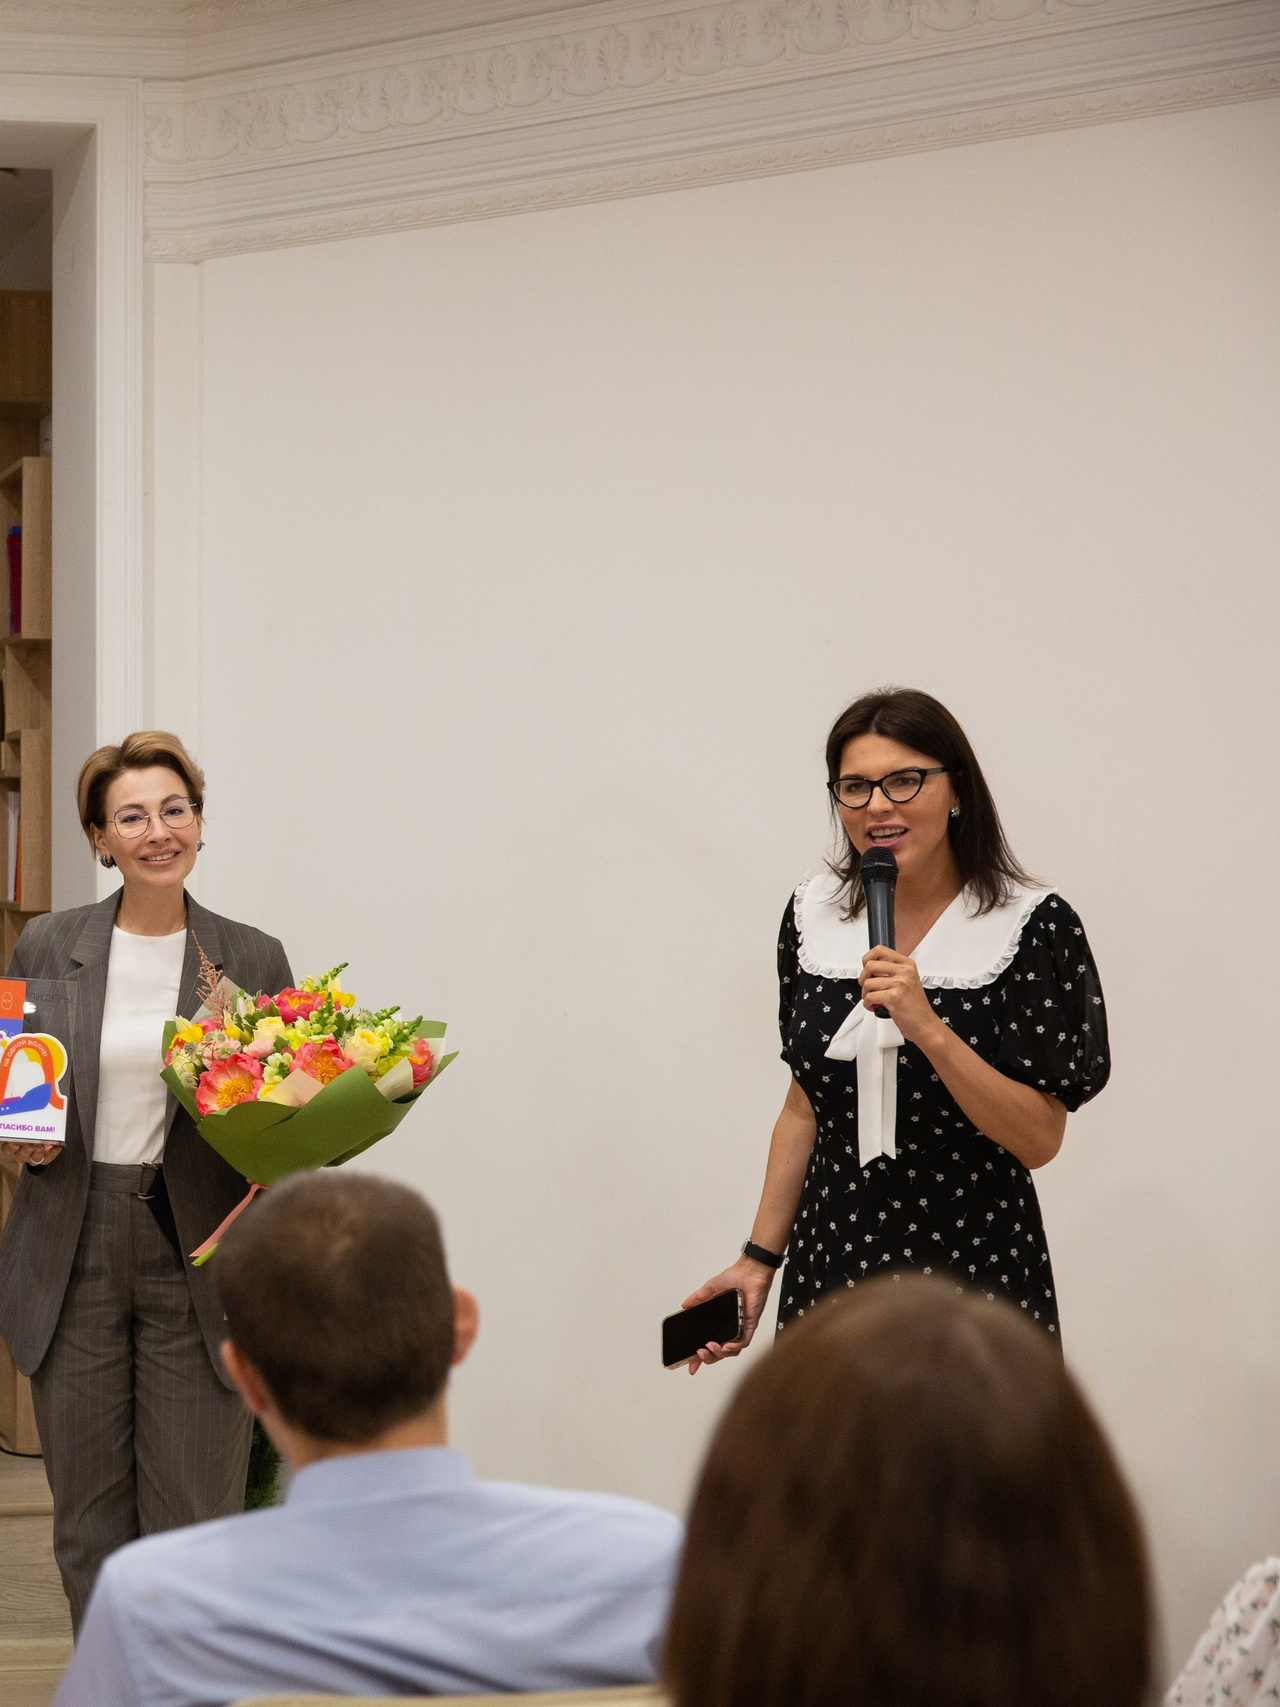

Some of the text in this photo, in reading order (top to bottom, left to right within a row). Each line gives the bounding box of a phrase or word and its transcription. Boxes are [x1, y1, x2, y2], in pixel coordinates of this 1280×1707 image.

[3, 1058, 10, 1067] НА
[7, 1040, 27, 1058] ОДНОЙ
[34, 1125, 56, 1133] ВАМ!
